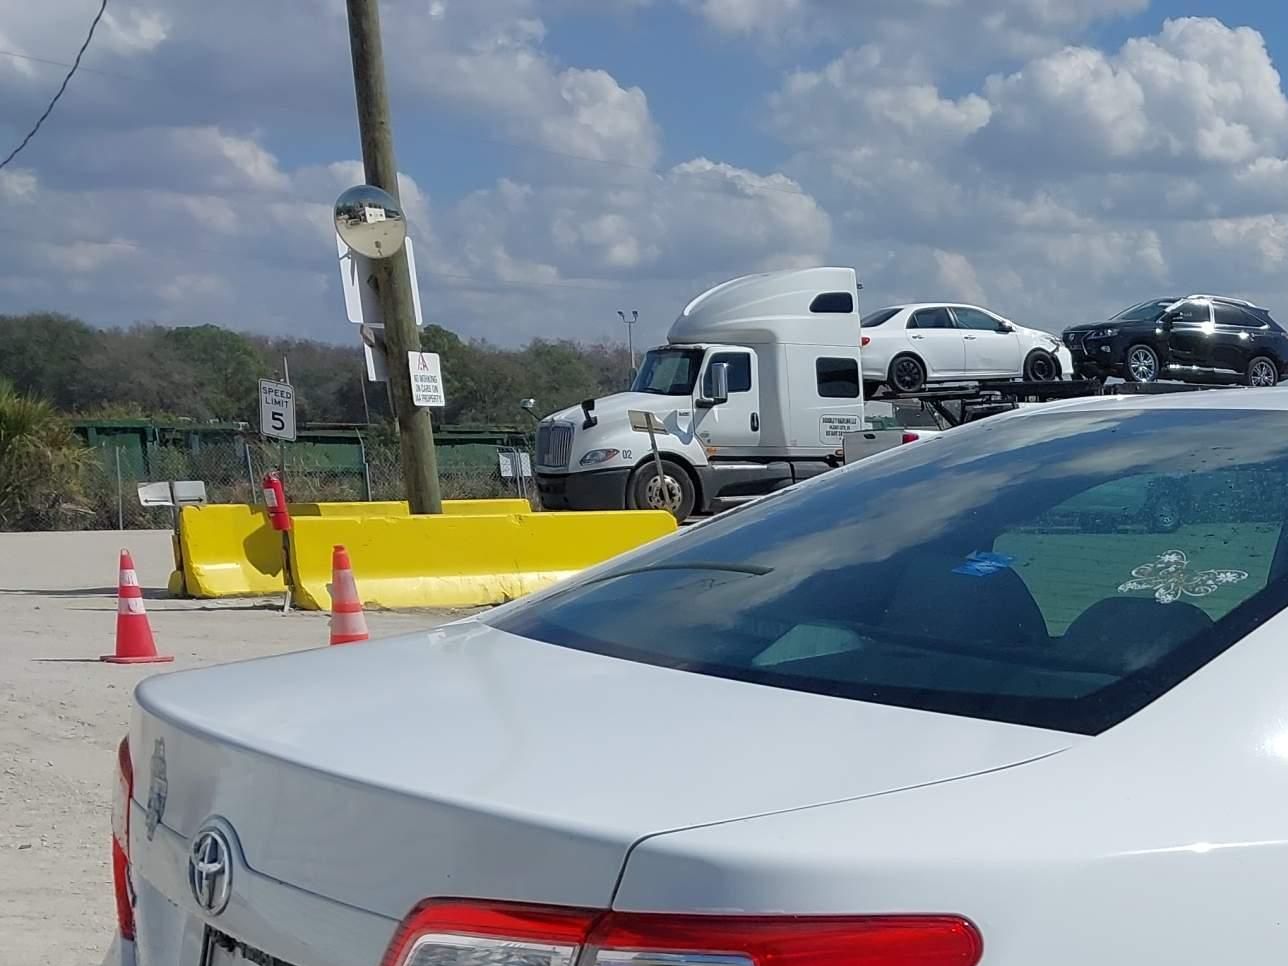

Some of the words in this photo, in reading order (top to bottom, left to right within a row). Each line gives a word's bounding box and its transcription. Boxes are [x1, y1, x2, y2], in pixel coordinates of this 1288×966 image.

[262, 386, 292, 400] SPEED
[265, 396, 289, 409] LIMIT
[271, 410, 286, 431] 5
[622, 449, 633, 460] 02
